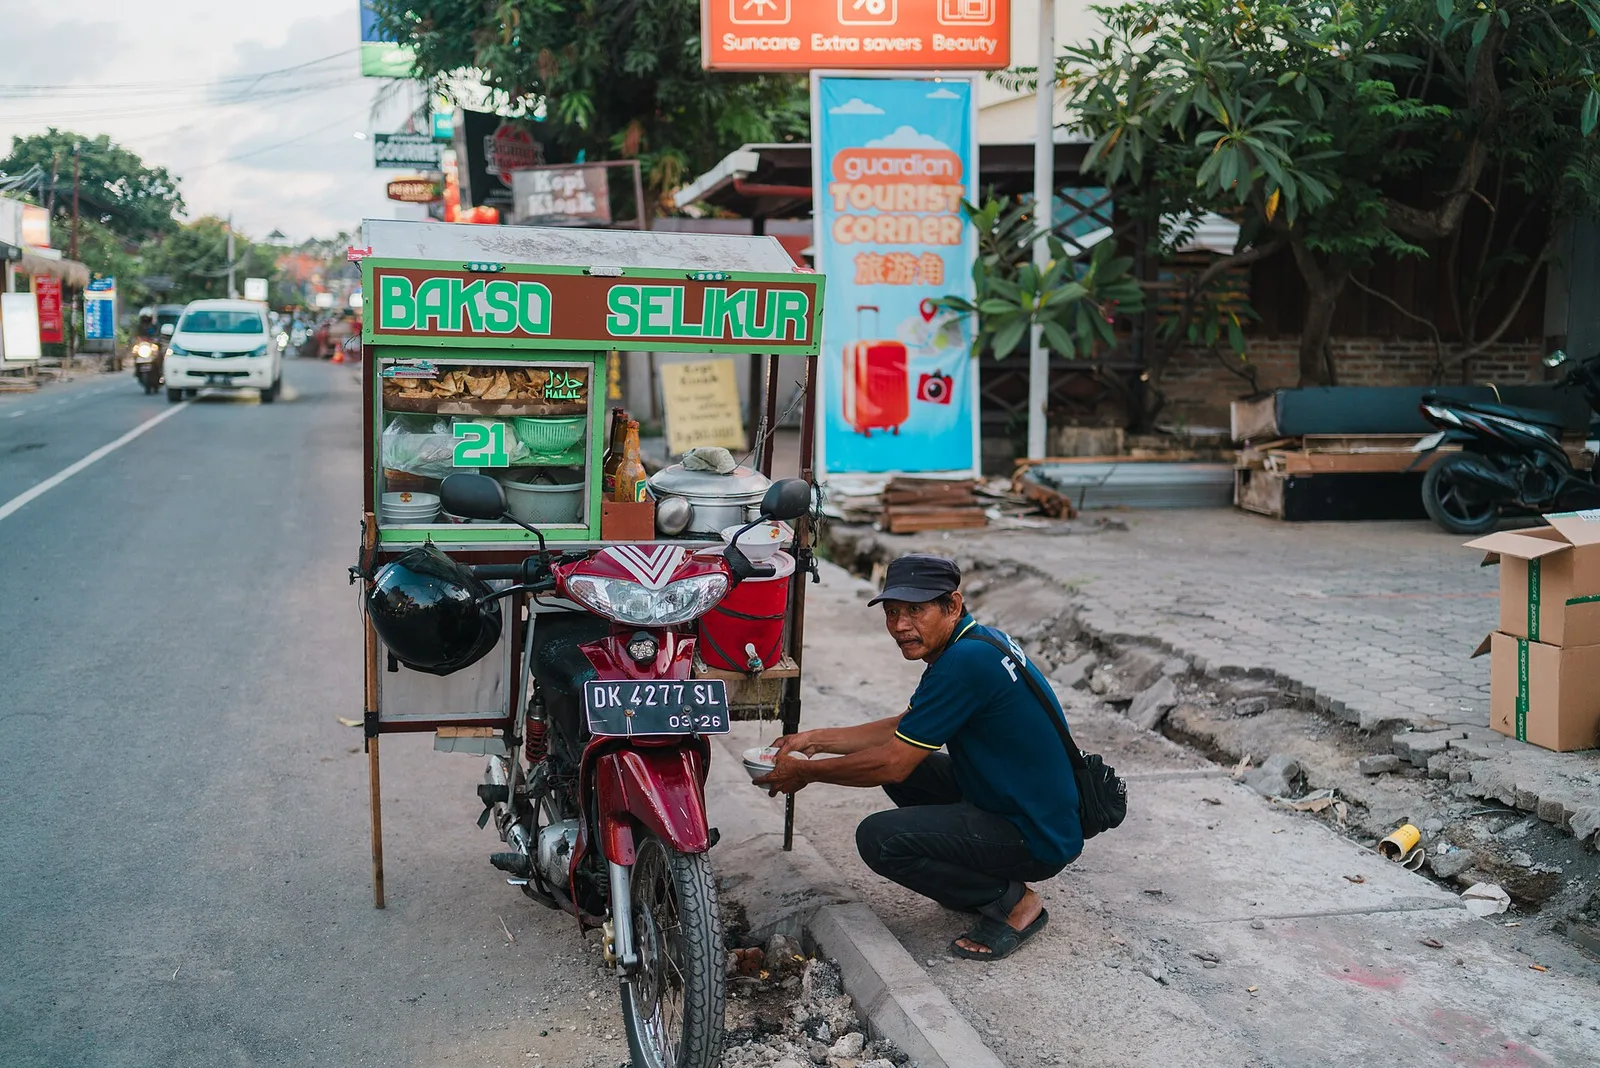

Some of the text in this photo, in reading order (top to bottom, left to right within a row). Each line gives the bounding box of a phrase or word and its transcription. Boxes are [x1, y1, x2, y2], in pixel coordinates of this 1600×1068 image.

[722, 33, 801, 51] Suncare
[810, 33, 923, 52] Extra savers
[932, 33, 998, 55] Beauty
[843, 154, 954, 180] guardian
[829, 183, 964, 213] TOURIST
[853, 252, 944, 286] 旅游角
[379, 274, 810, 341] BAKSO SELIKUR
[545, 369, 583, 389] حلال
[545, 389, 581, 399] HALAL
[453, 422, 510, 468] 21
[594, 684, 721, 708] DK 4277 SL
